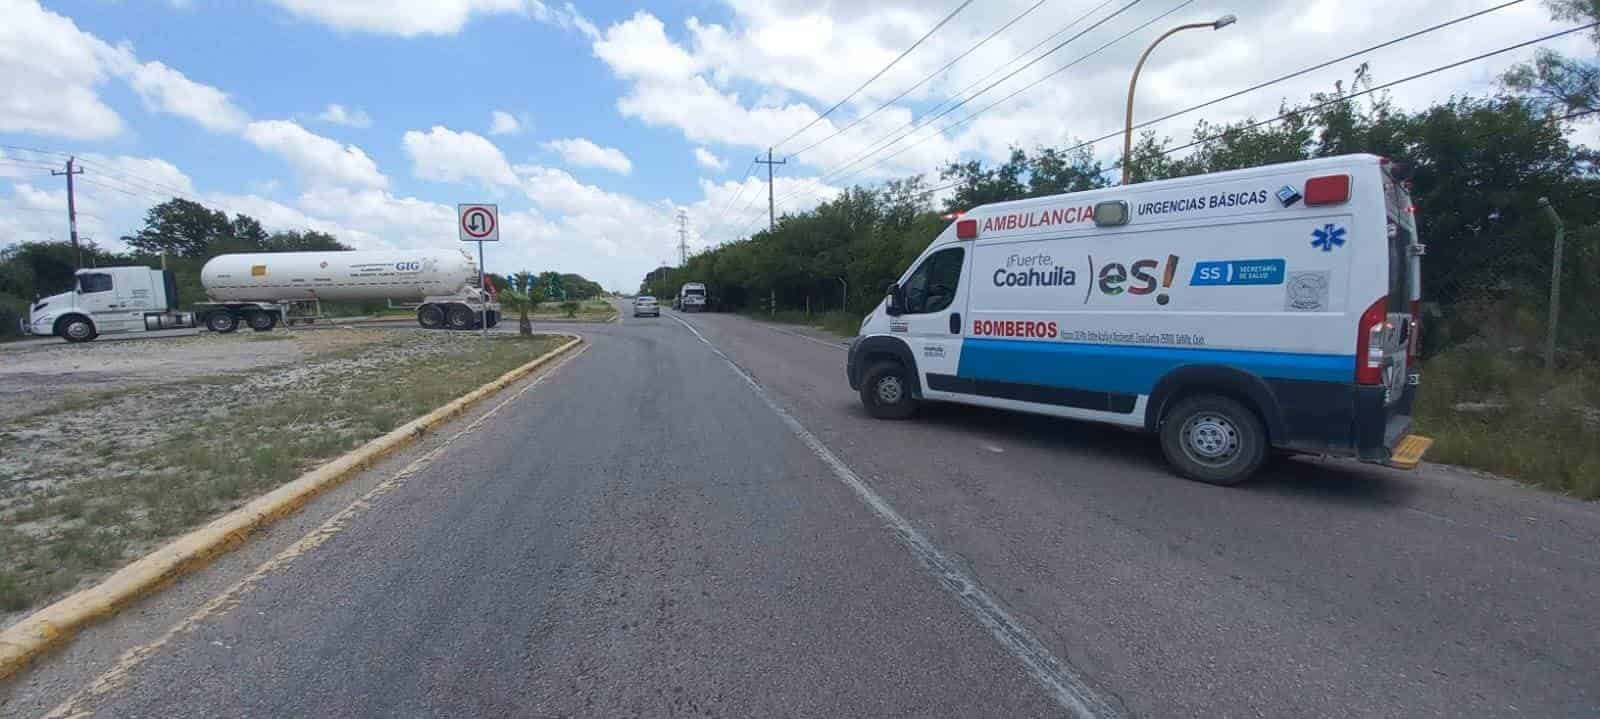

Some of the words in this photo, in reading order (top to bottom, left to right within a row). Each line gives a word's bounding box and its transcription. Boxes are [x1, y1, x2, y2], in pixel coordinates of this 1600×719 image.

[1137, 196, 1206, 217] URGENCIAS
[1209, 189, 1268, 210] BÁSICAS
[983, 205, 1095, 233] AMBULANCIA
[993, 266, 1077, 287] Coahuila
[1199, 267, 1221, 280] SS
[973, 319, 1058, 338] BOMBEROS
